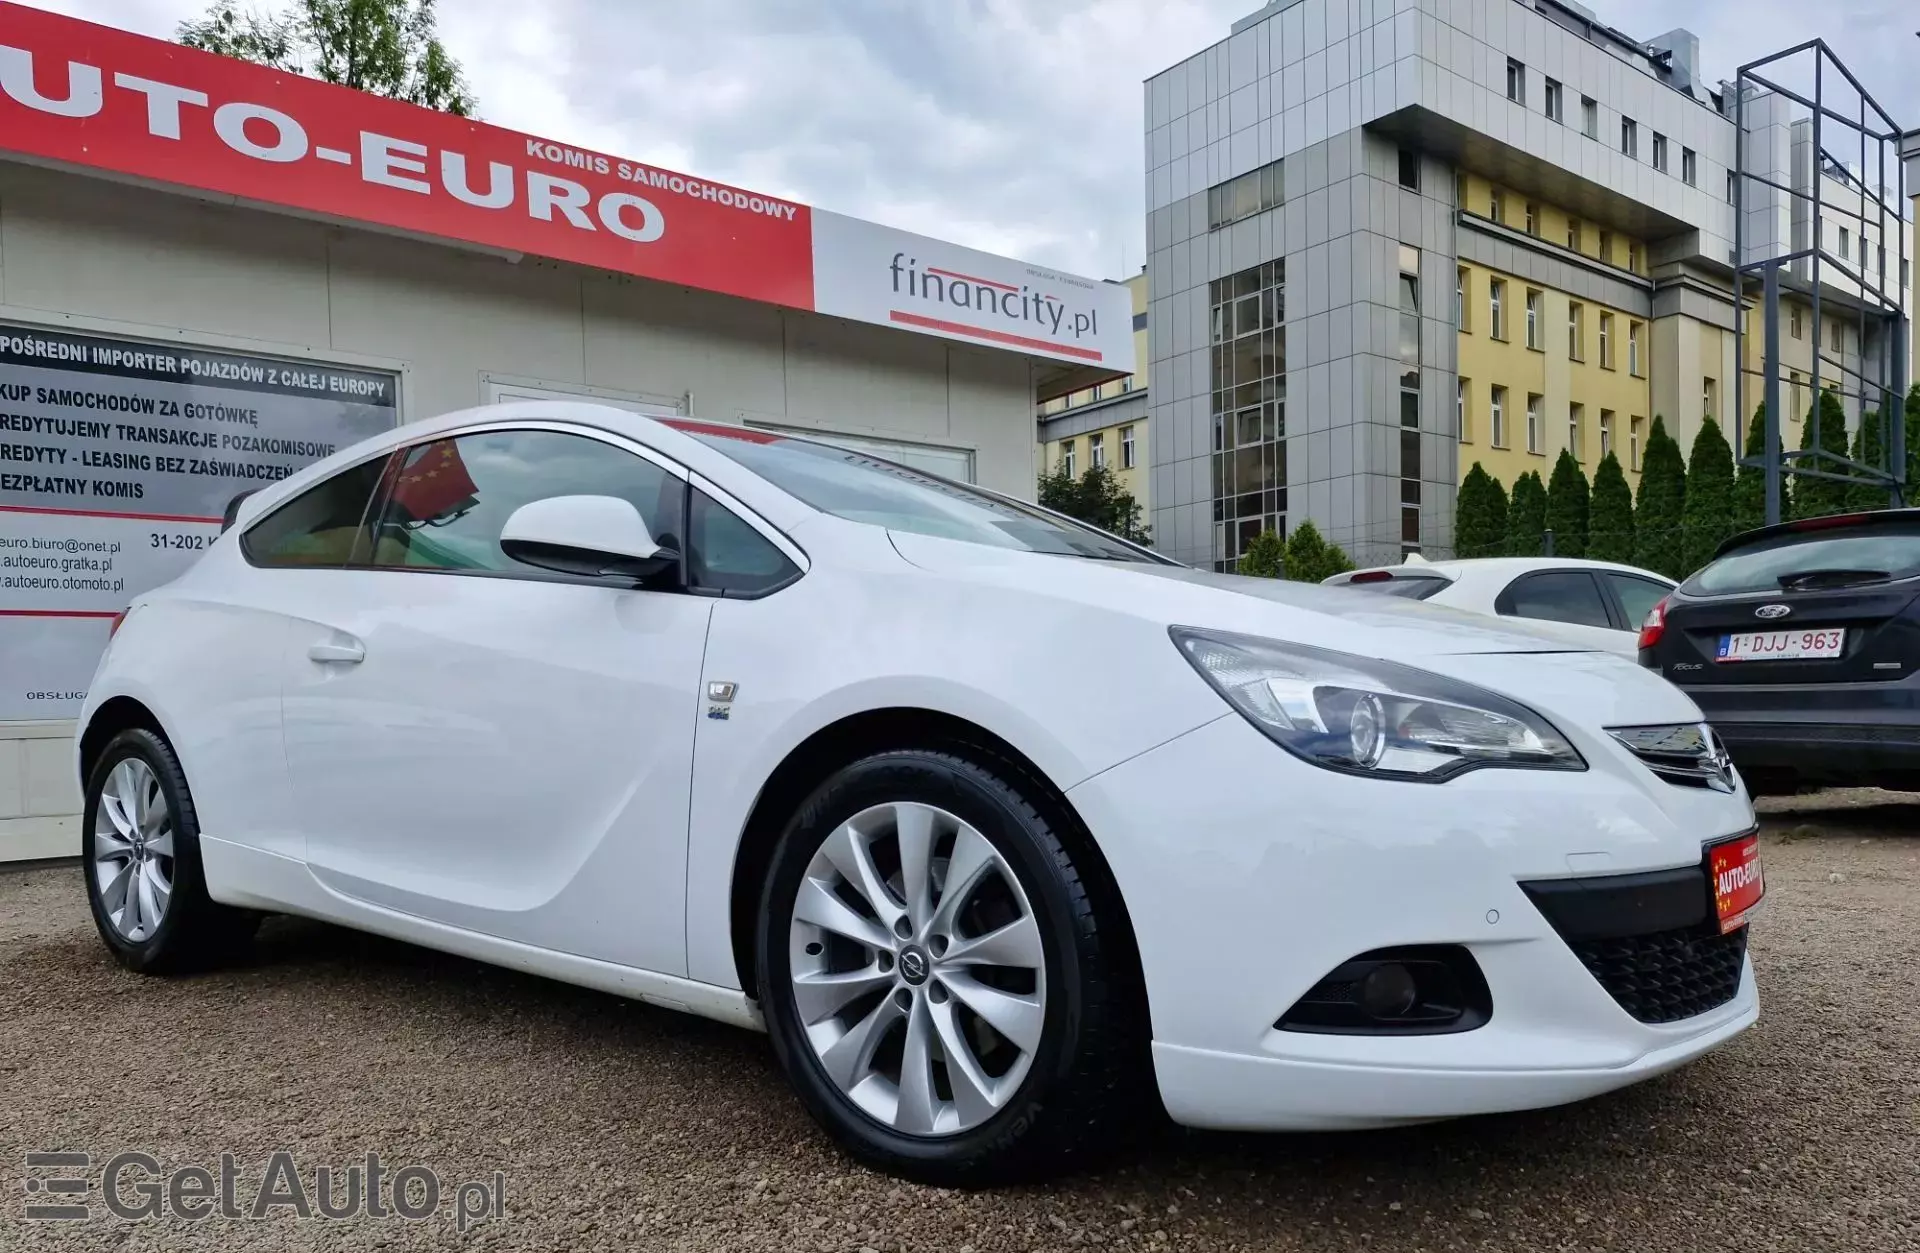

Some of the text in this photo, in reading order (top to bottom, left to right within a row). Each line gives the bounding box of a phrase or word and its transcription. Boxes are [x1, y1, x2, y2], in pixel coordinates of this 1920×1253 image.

[526, 139, 796, 221] KOMIS SAMOCHODOWY
[889, 253, 1098, 338] financity.pl
[0, 335, 385, 397] POŚREDNI IMPORTER POJAZDÓW Z CAŁEJ EUROPY
[37, 387, 154, 414] SAMOCHODÓW
[160, 400, 180, 417] ZA
[184, 403, 258, 428] GOTÓWKĘ
[116, 424, 218, 449] TRANSAKCJE
[222, 434, 336, 458] POZAKOMISOWE
[82, 450, 151, 471] LEASING
[155, 456, 185, 474] BEZ
[189, 458, 293, 481] ZAŚWIADCZEŃ
[93, 480, 144, 499] KOMIS
[151, 533, 203, 550] 31-202
[0, 574, 124, 593] .autoeuro.otomoto.pl
